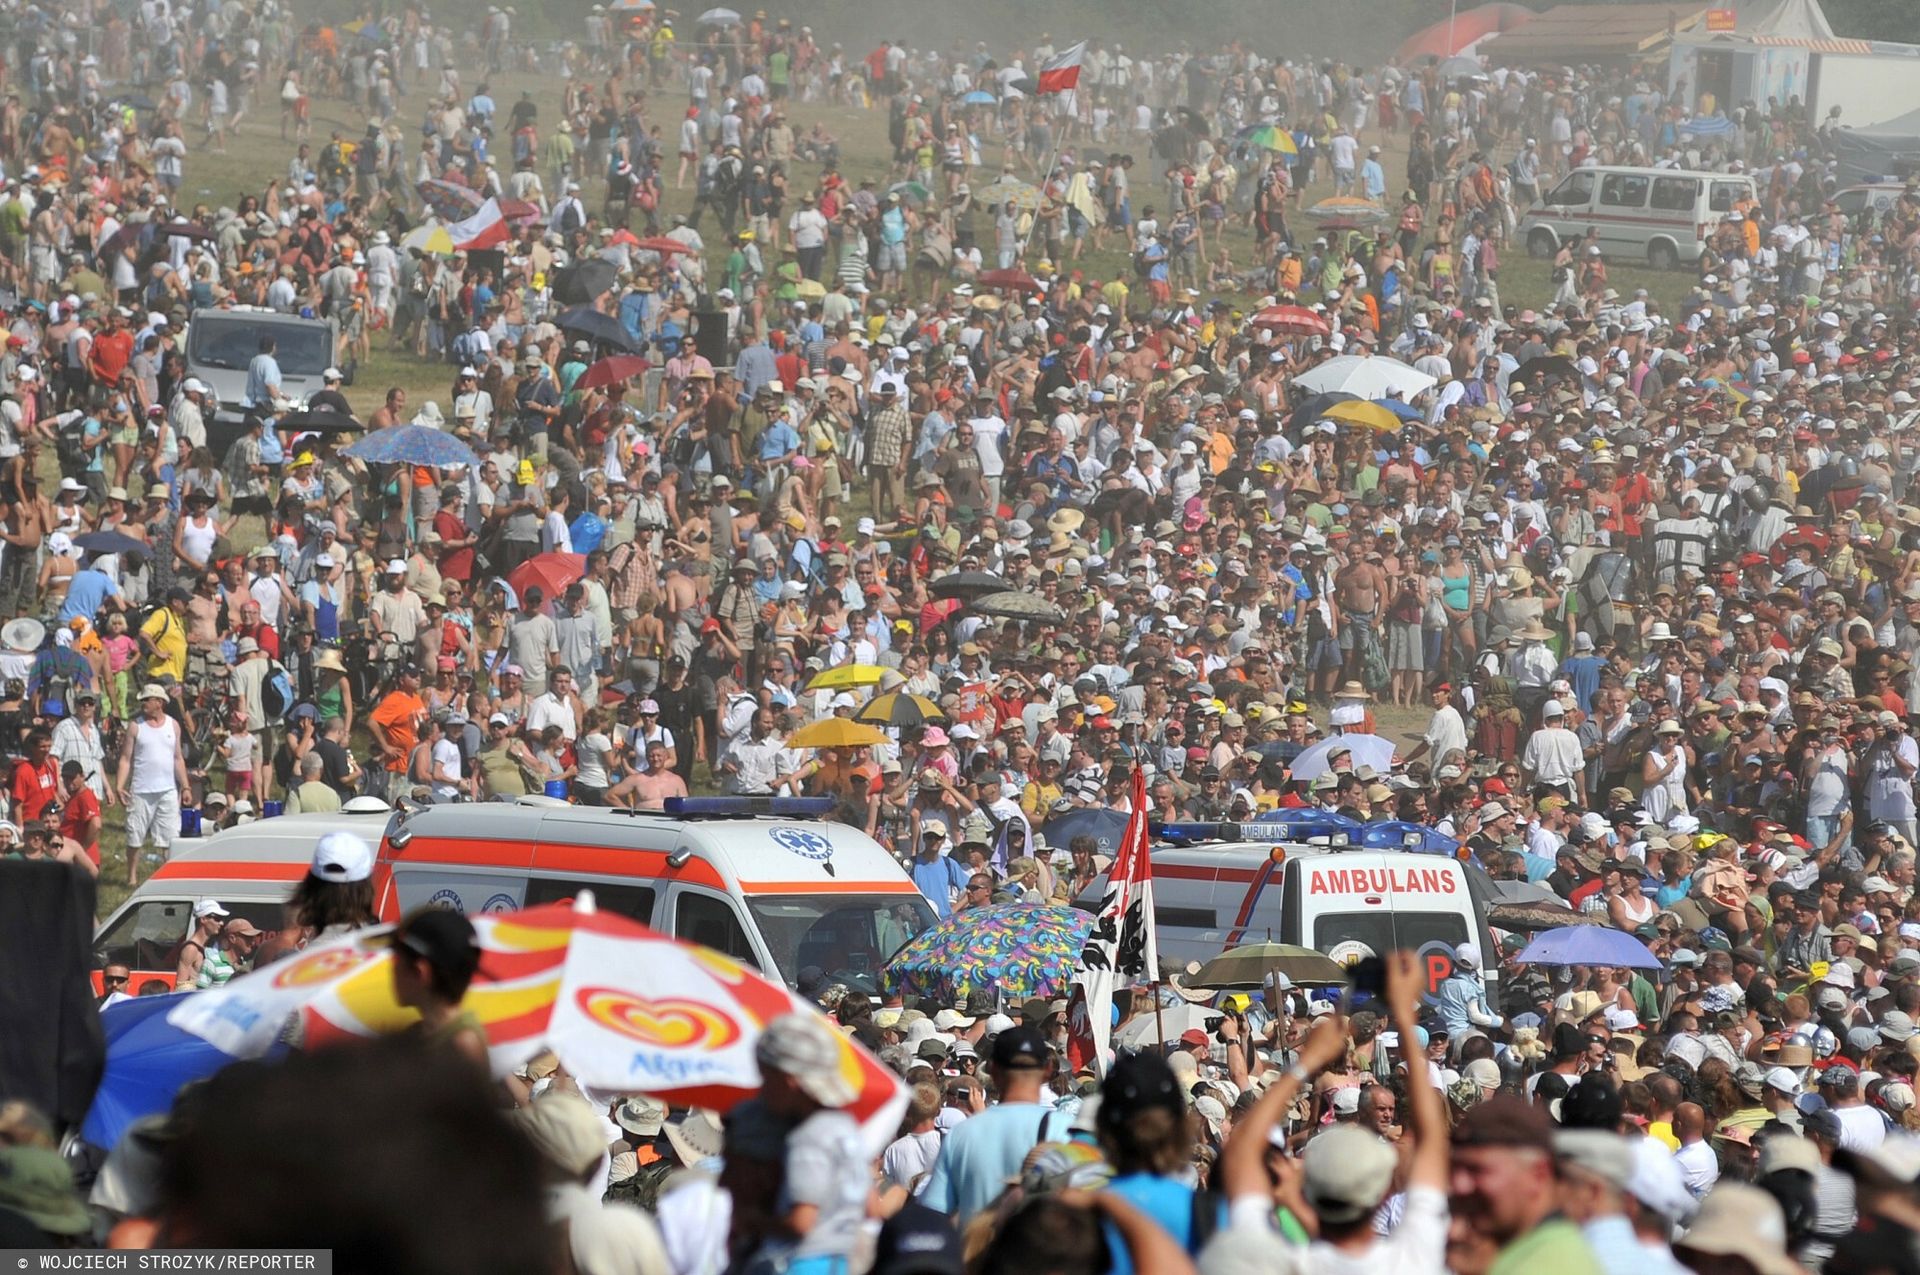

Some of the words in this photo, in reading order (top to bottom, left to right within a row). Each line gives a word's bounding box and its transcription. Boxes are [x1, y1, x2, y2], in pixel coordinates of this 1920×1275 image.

[1241, 824, 1288, 839] AMBULANS
[1310, 869, 1456, 895] AMBULANS
[1427, 955, 1453, 993] P
